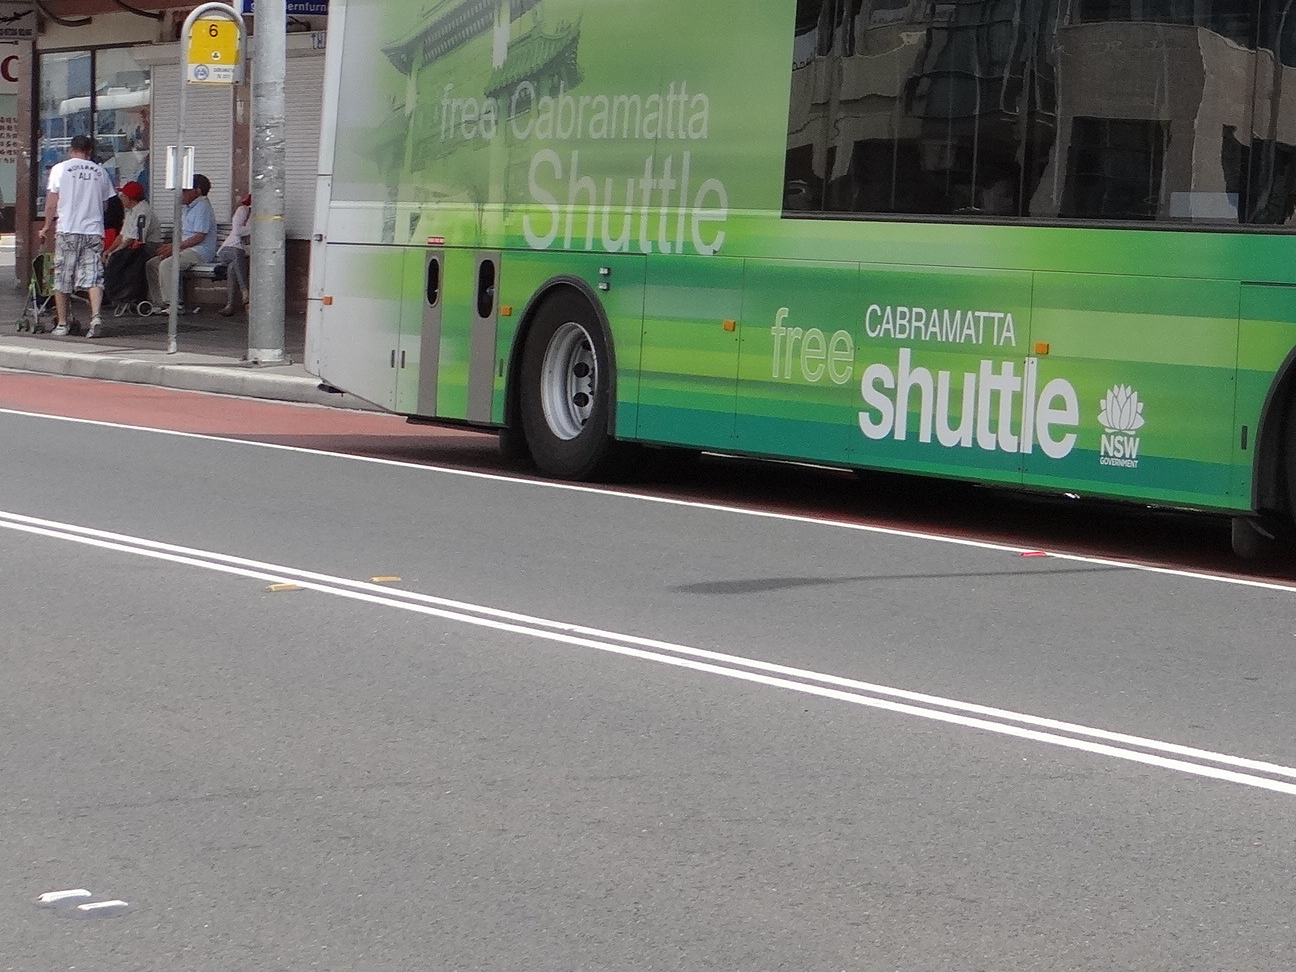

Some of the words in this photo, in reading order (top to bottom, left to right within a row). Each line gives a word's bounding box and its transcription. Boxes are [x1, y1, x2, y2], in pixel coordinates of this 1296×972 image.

[209, 23, 219, 37] 6
[440, 83, 498, 140] free
[511, 81, 710, 140] Cabramatta
[522, 148, 729, 256] Shuttle
[865, 304, 1017, 347] CABRAMATTA
[771, 307, 854, 385] free
[858, 347, 1079, 459] shuttle
[1100, 434, 1140, 459] NSW
[1100, 457, 1138, 468] GOVERNMENT
